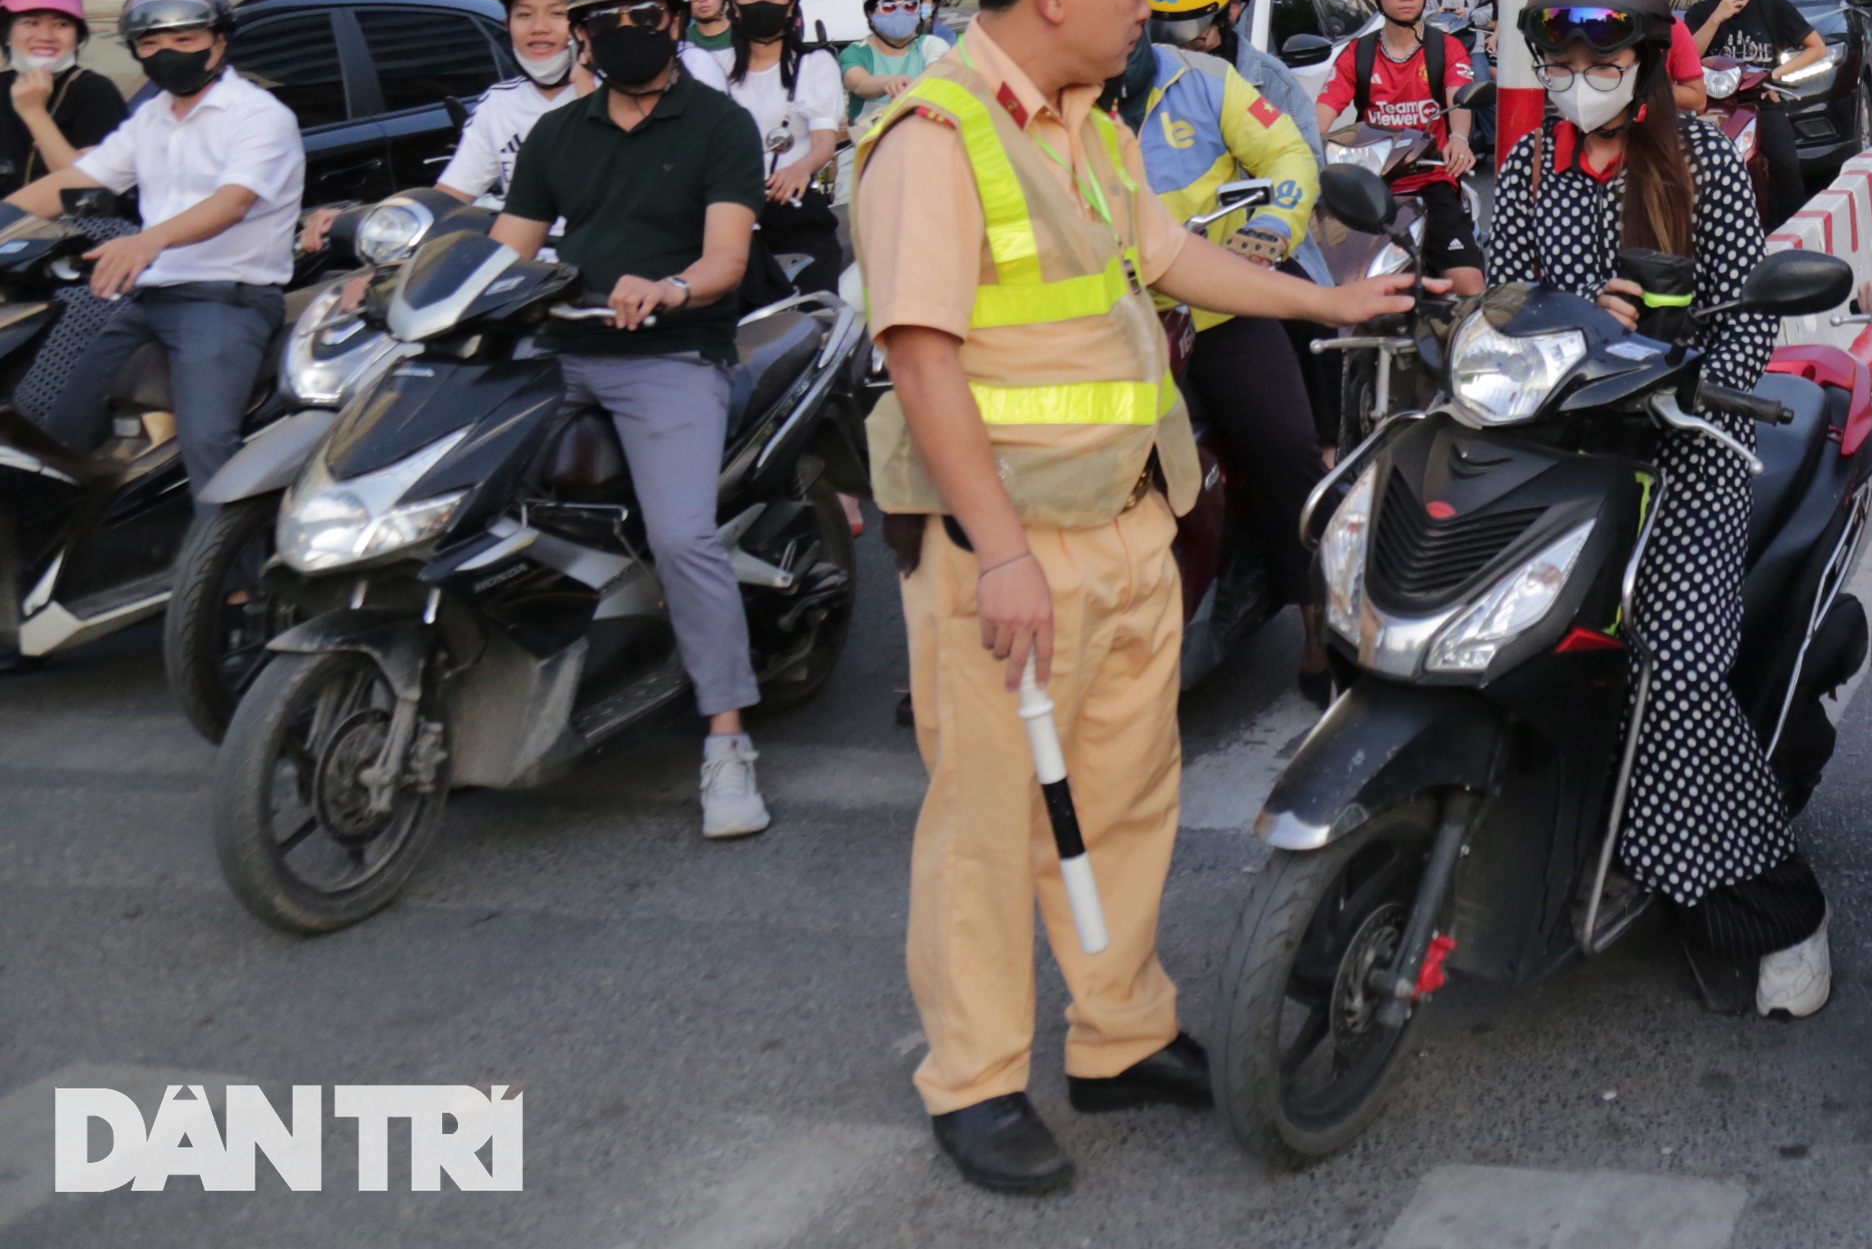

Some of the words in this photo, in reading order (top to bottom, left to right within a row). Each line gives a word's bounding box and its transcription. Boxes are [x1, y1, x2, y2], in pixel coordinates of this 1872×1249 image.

[1376, 101, 1418, 115] Team
[1368, 109, 1418, 126] Viewer
[474, 563, 528, 593] HONDA
